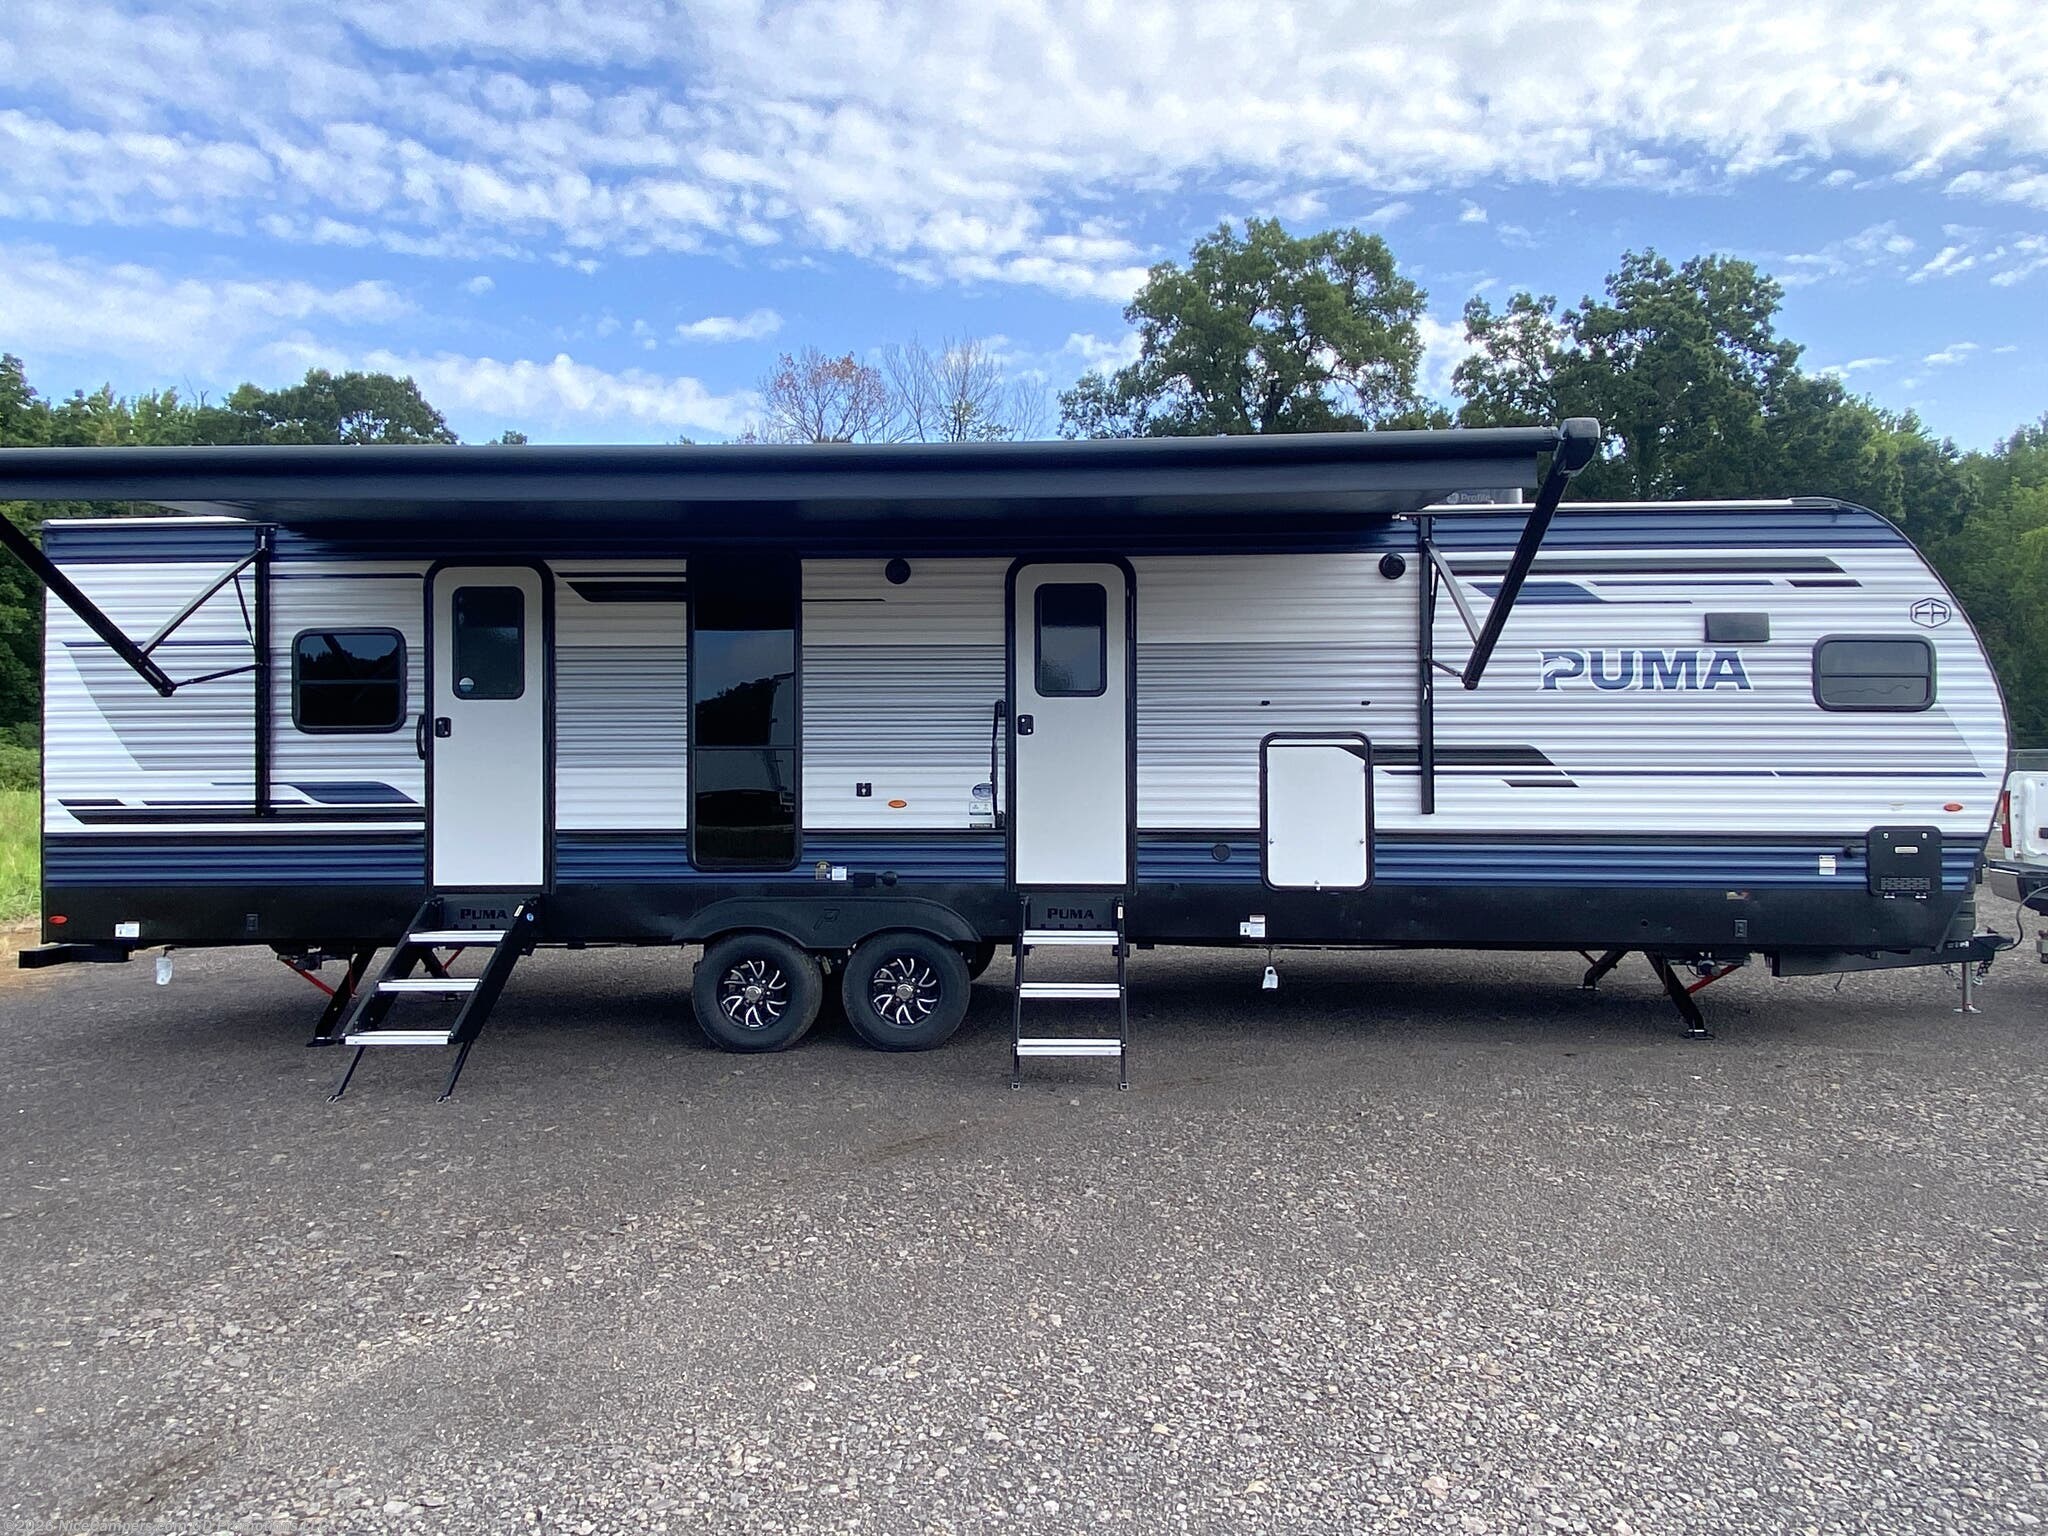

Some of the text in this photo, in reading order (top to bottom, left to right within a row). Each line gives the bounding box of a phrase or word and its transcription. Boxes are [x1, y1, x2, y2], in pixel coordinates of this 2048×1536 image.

[1540, 649, 1752, 691] PUMA
[460, 908, 508, 920] PUMA
[1047, 907, 1095, 920] PUMA
